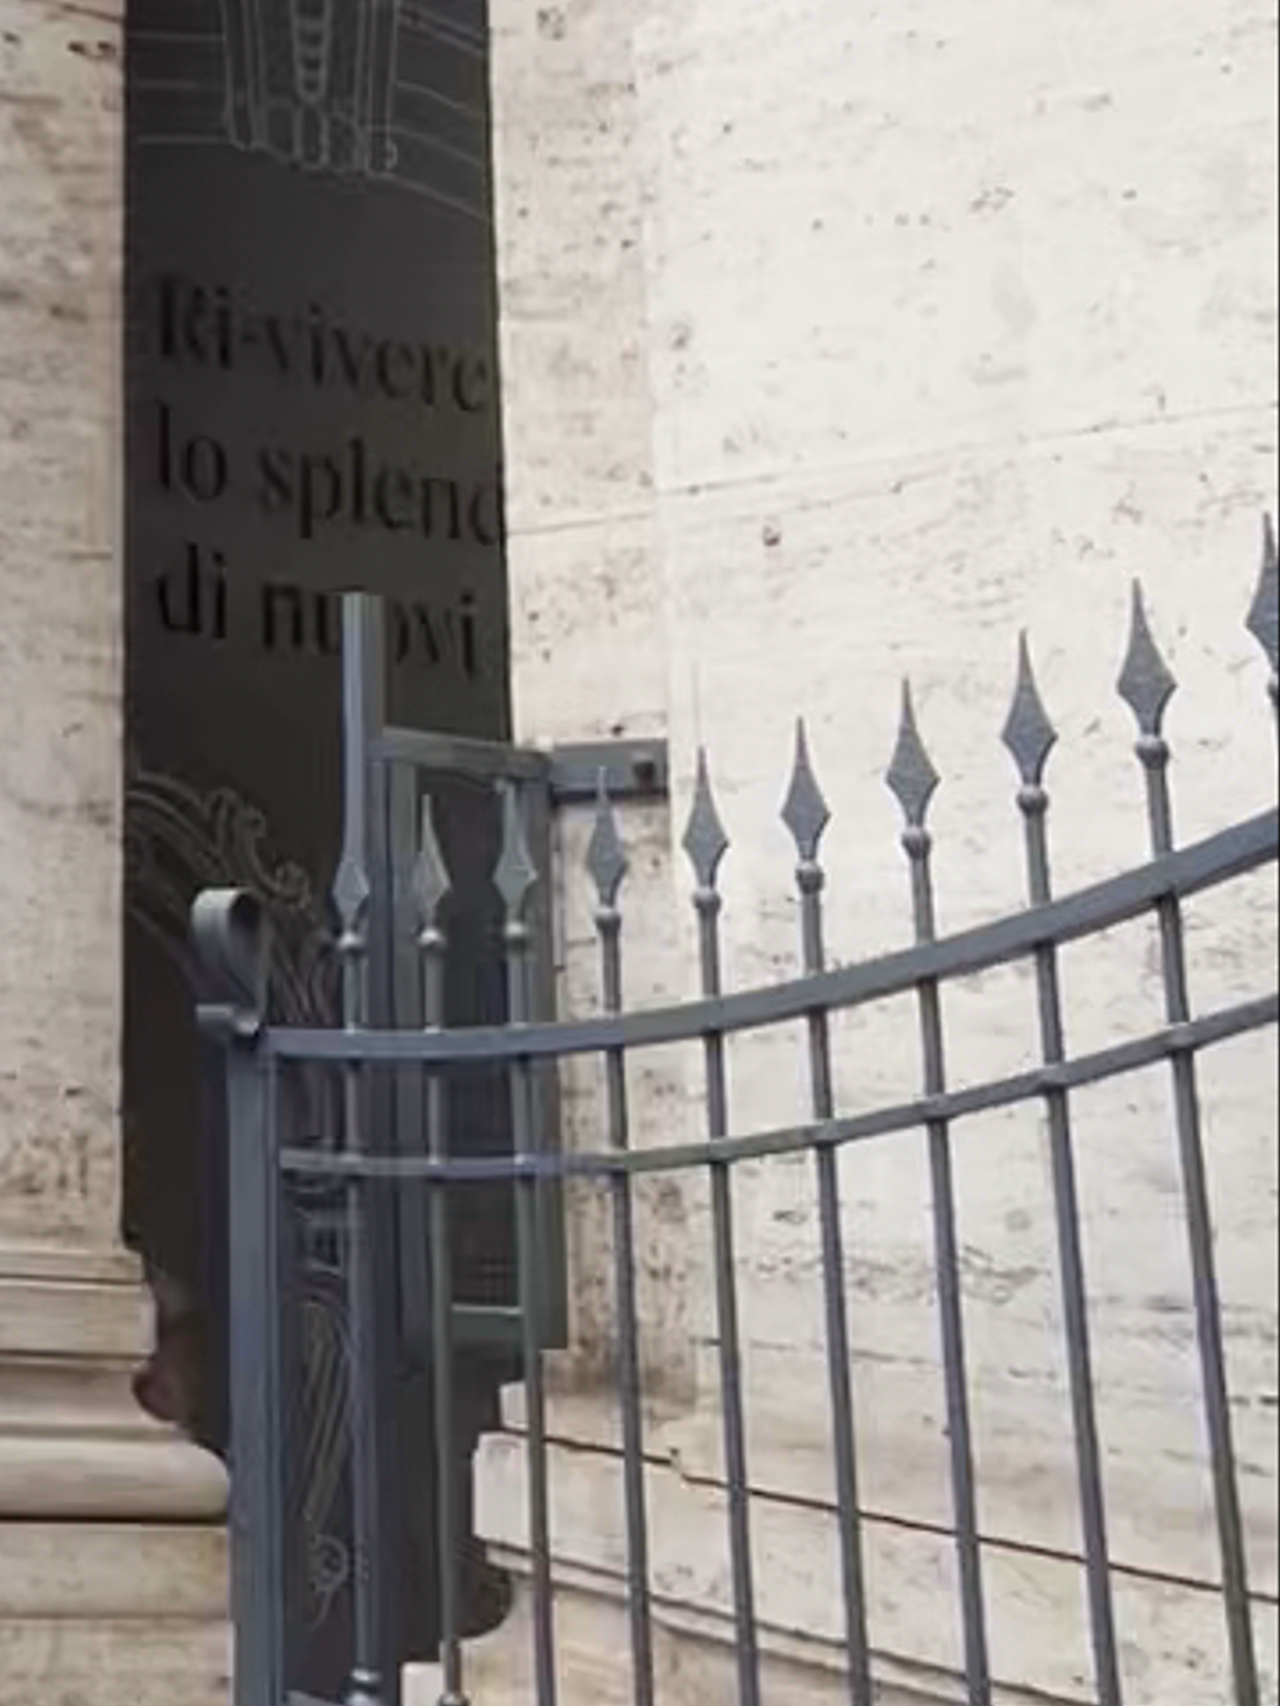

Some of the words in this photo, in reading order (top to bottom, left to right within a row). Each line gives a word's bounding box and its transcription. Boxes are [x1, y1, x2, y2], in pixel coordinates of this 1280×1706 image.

[154, 273, 490, 414] Ri-vivere
[154, 398, 228, 502] lo
[155, 541, 228, 640] di
